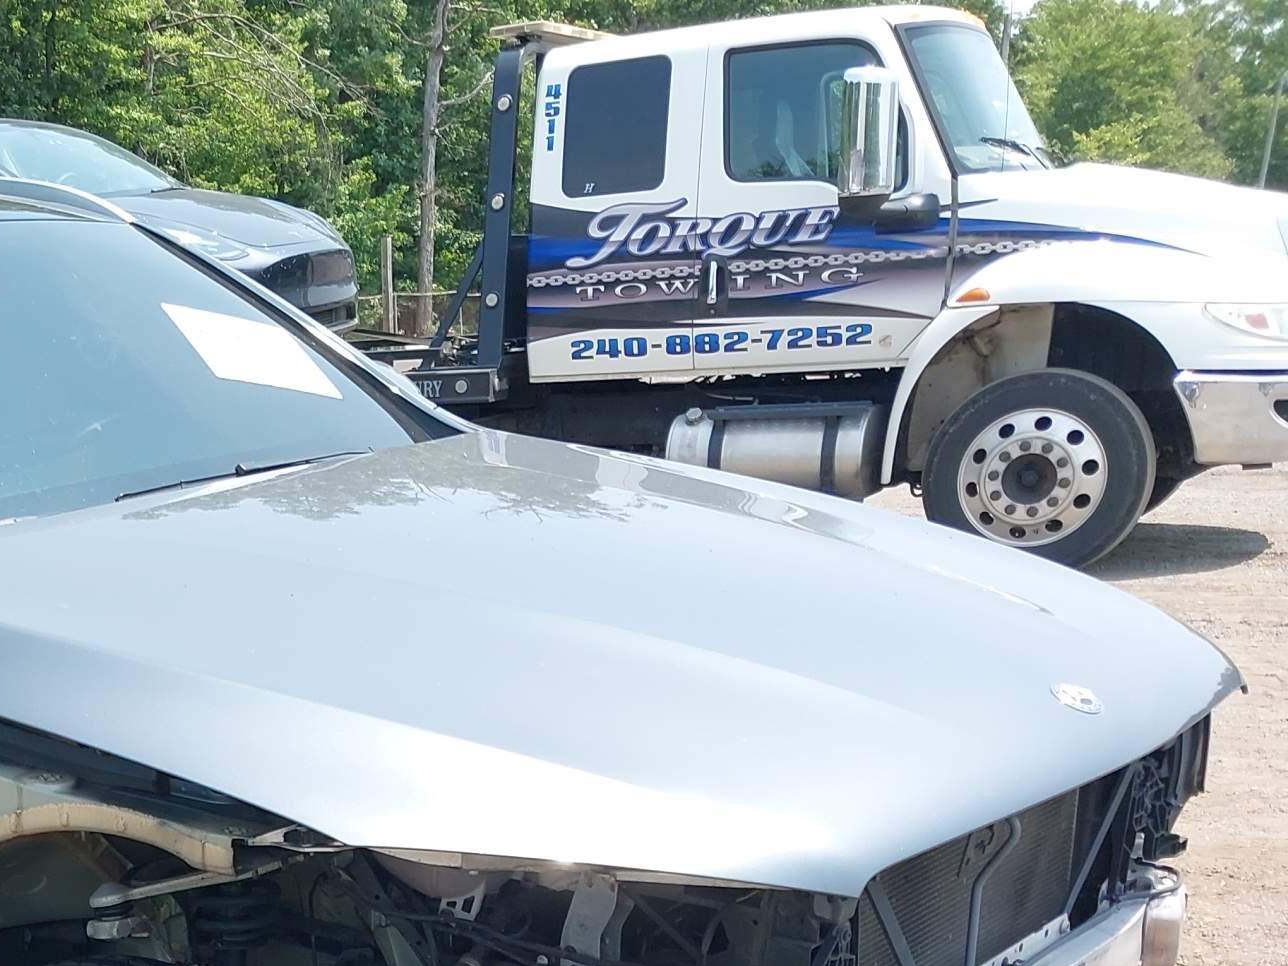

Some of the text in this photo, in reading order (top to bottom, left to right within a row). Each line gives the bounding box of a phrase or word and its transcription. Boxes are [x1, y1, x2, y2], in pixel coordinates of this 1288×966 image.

[545, 83, 562, 152] 4511
[575, 267, 864, 302] TOWING
[570, 323, 873, 361] 240-882-7252
